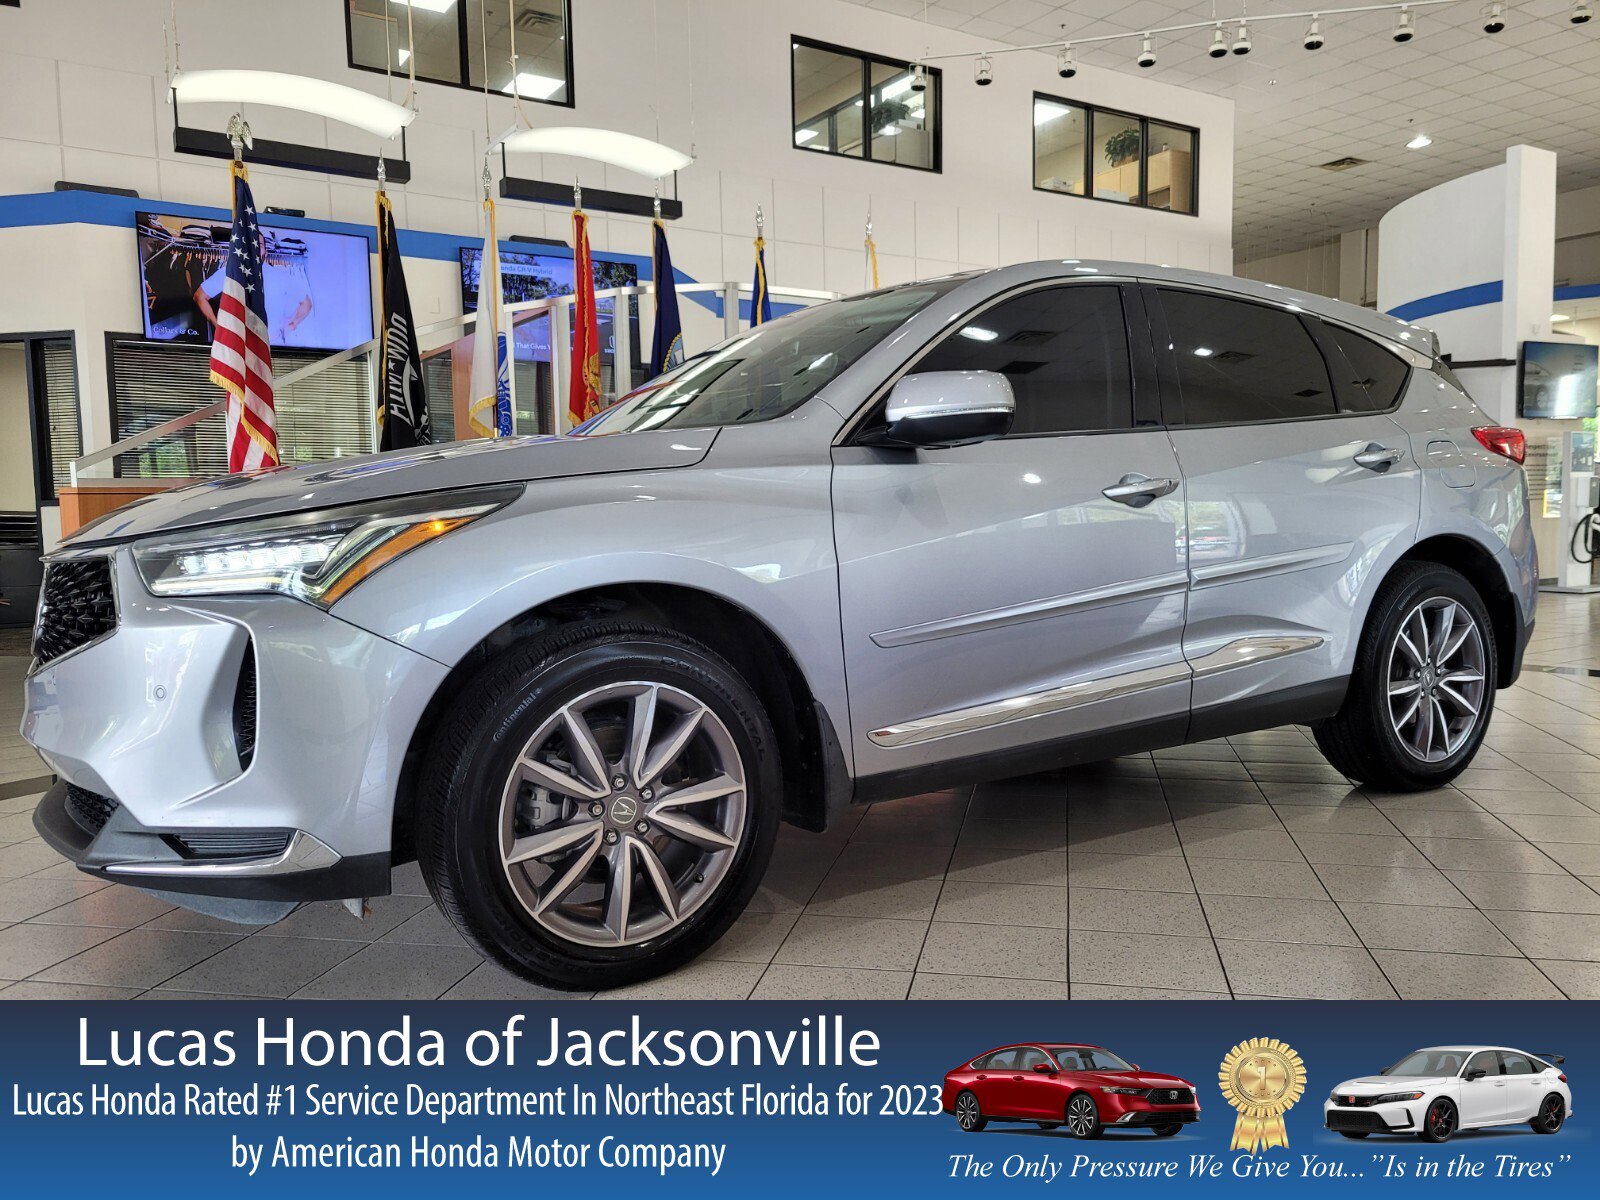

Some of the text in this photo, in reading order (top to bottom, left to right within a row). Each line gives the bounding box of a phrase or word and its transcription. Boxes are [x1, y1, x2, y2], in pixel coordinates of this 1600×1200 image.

[500, 264, 516, 272] onda
[533, 268, 553, 276] Hybrid
[153, 326, 178, 335] Collars
[187, 328, 200, 336] Co.
[492, 690, 538, 743] Continental
